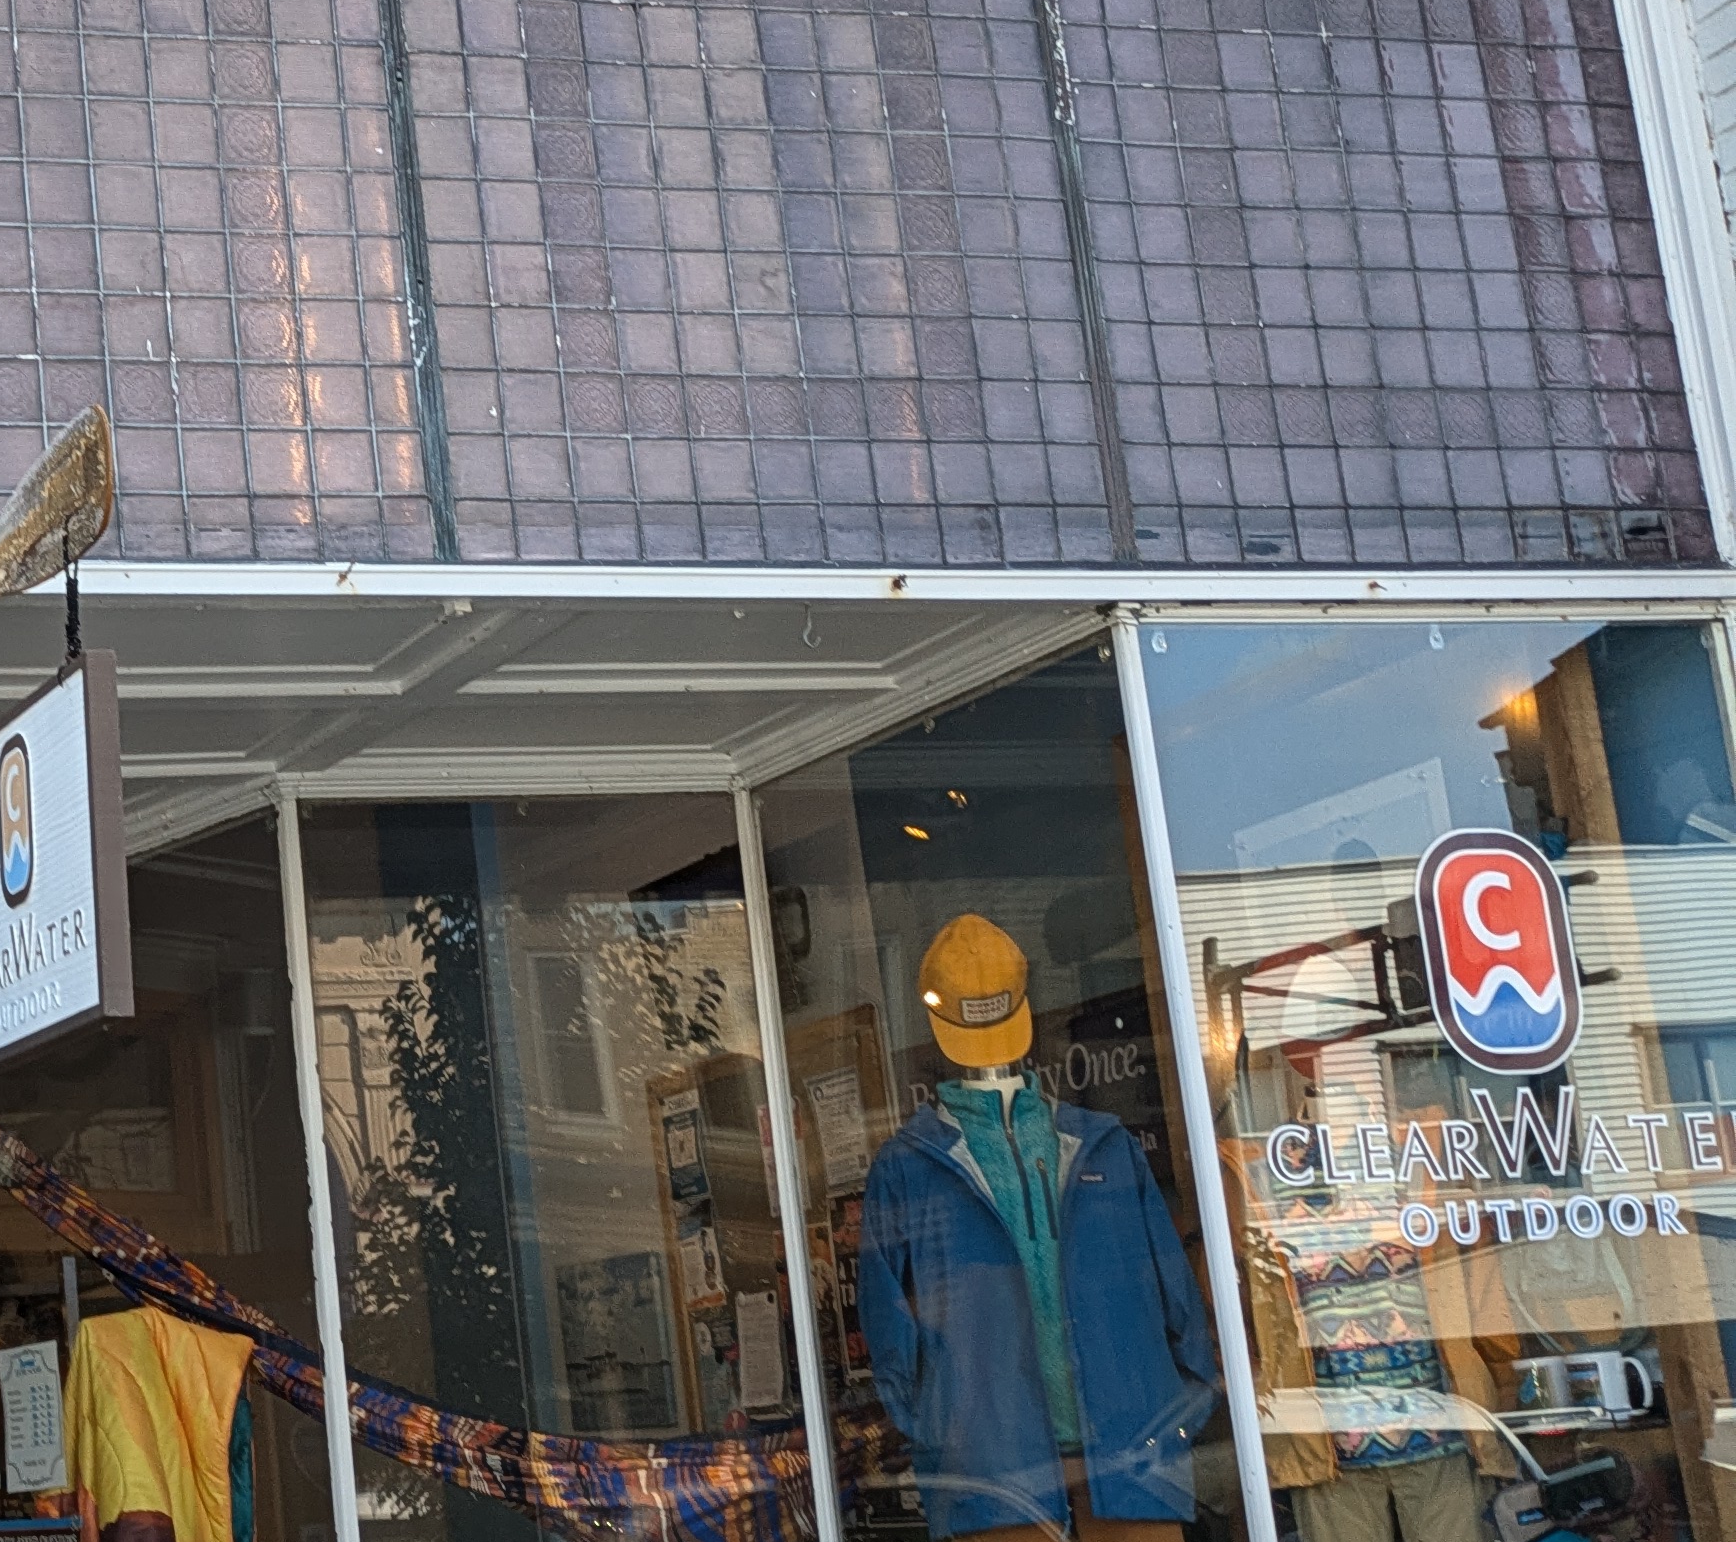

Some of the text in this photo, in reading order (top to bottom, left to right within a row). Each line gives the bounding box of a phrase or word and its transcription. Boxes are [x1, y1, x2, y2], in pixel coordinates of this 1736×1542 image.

[1463, 871, 1522, 951] C
[1266, 1085, 1736, 1187] CLEARWATE
[1400, 1193, 1689, 1247] OUTDOOR
